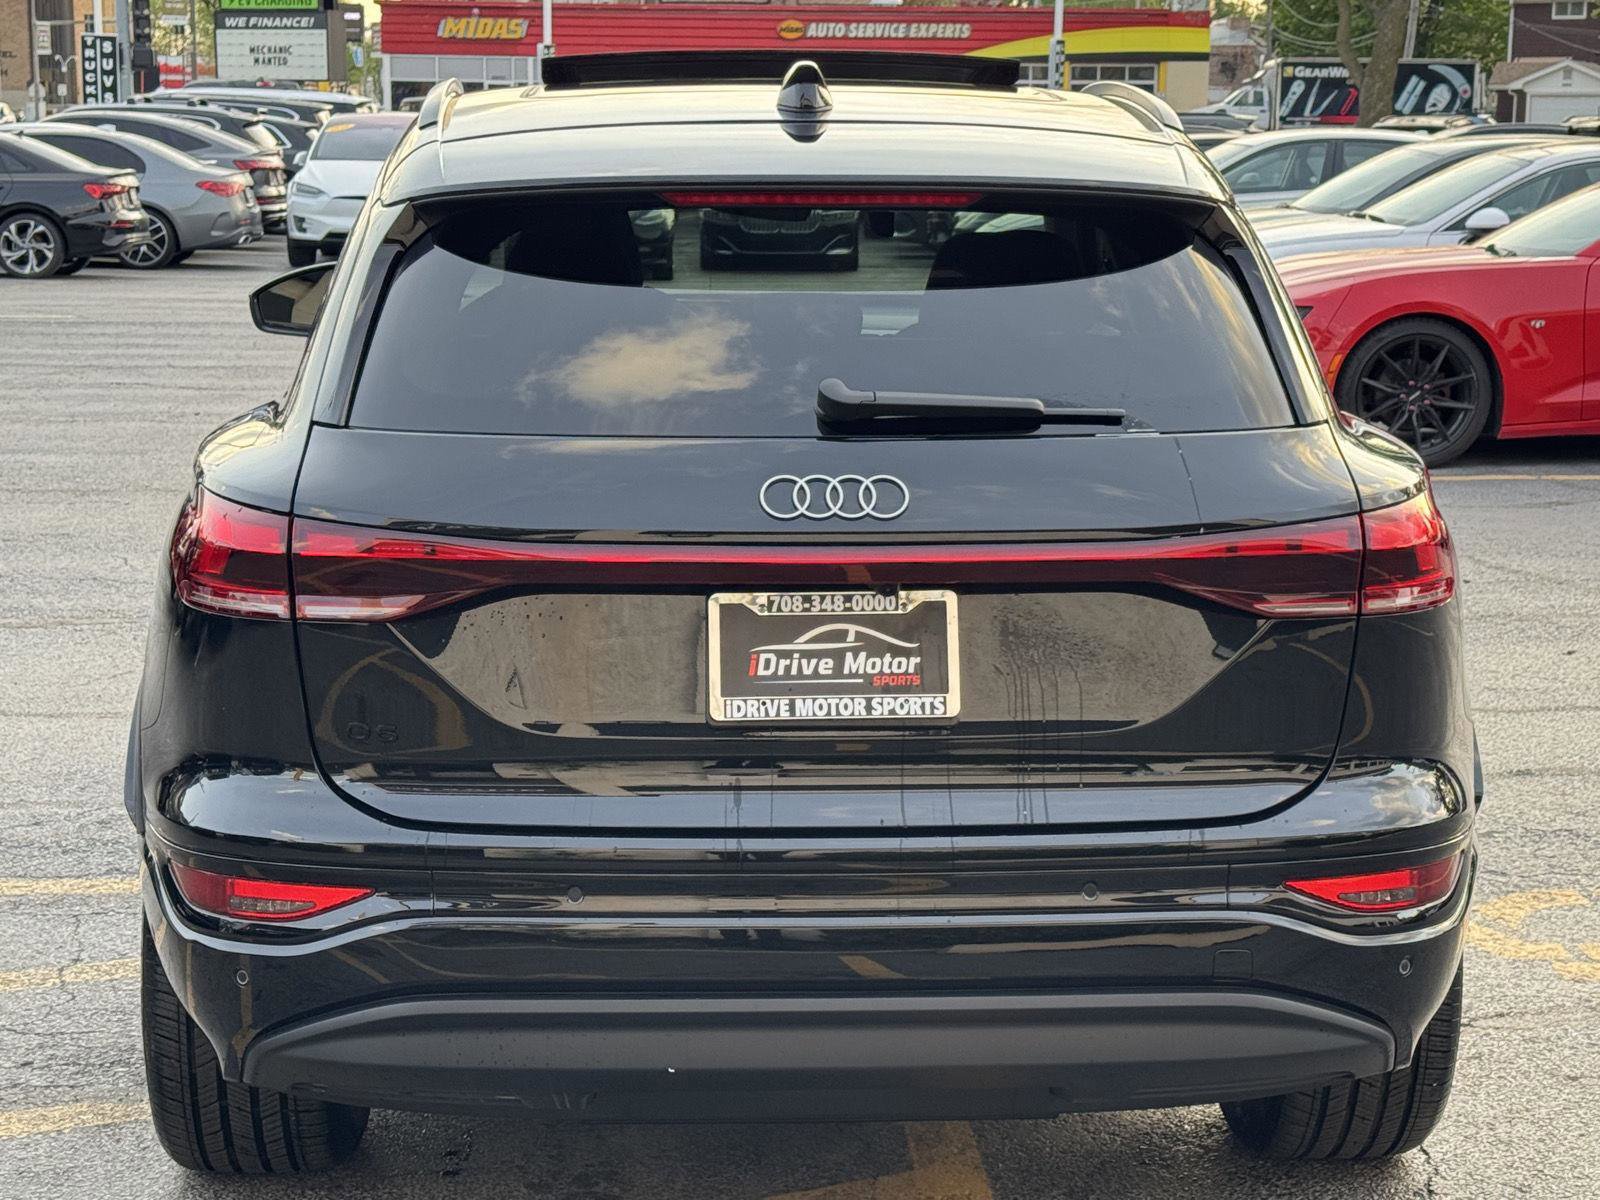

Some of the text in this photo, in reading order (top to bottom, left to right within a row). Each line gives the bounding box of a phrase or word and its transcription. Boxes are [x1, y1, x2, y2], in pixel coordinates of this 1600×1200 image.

[225, 16, 315, 28] WE FINANCE!
[438, 8, 528, 39] MIDAS
[806, 22, 971, 39] AUTO SERVICE EXPERTS
[249, 44, 293, 56] MECHANIC
[83, 36, 97, 105] TRUCKS
[253, 56, 289, 67] WANTED
[101, 40, 115, 104] SUVS
[769, 594, 898, 613] 708-348-0000
[749, 651, 922, 677] iDrive Motor
[872, 675, 921, 687] SPORTS
[795, 697, 867, 718] MOTOR
[871, 696, 945, 717] SPORTS
